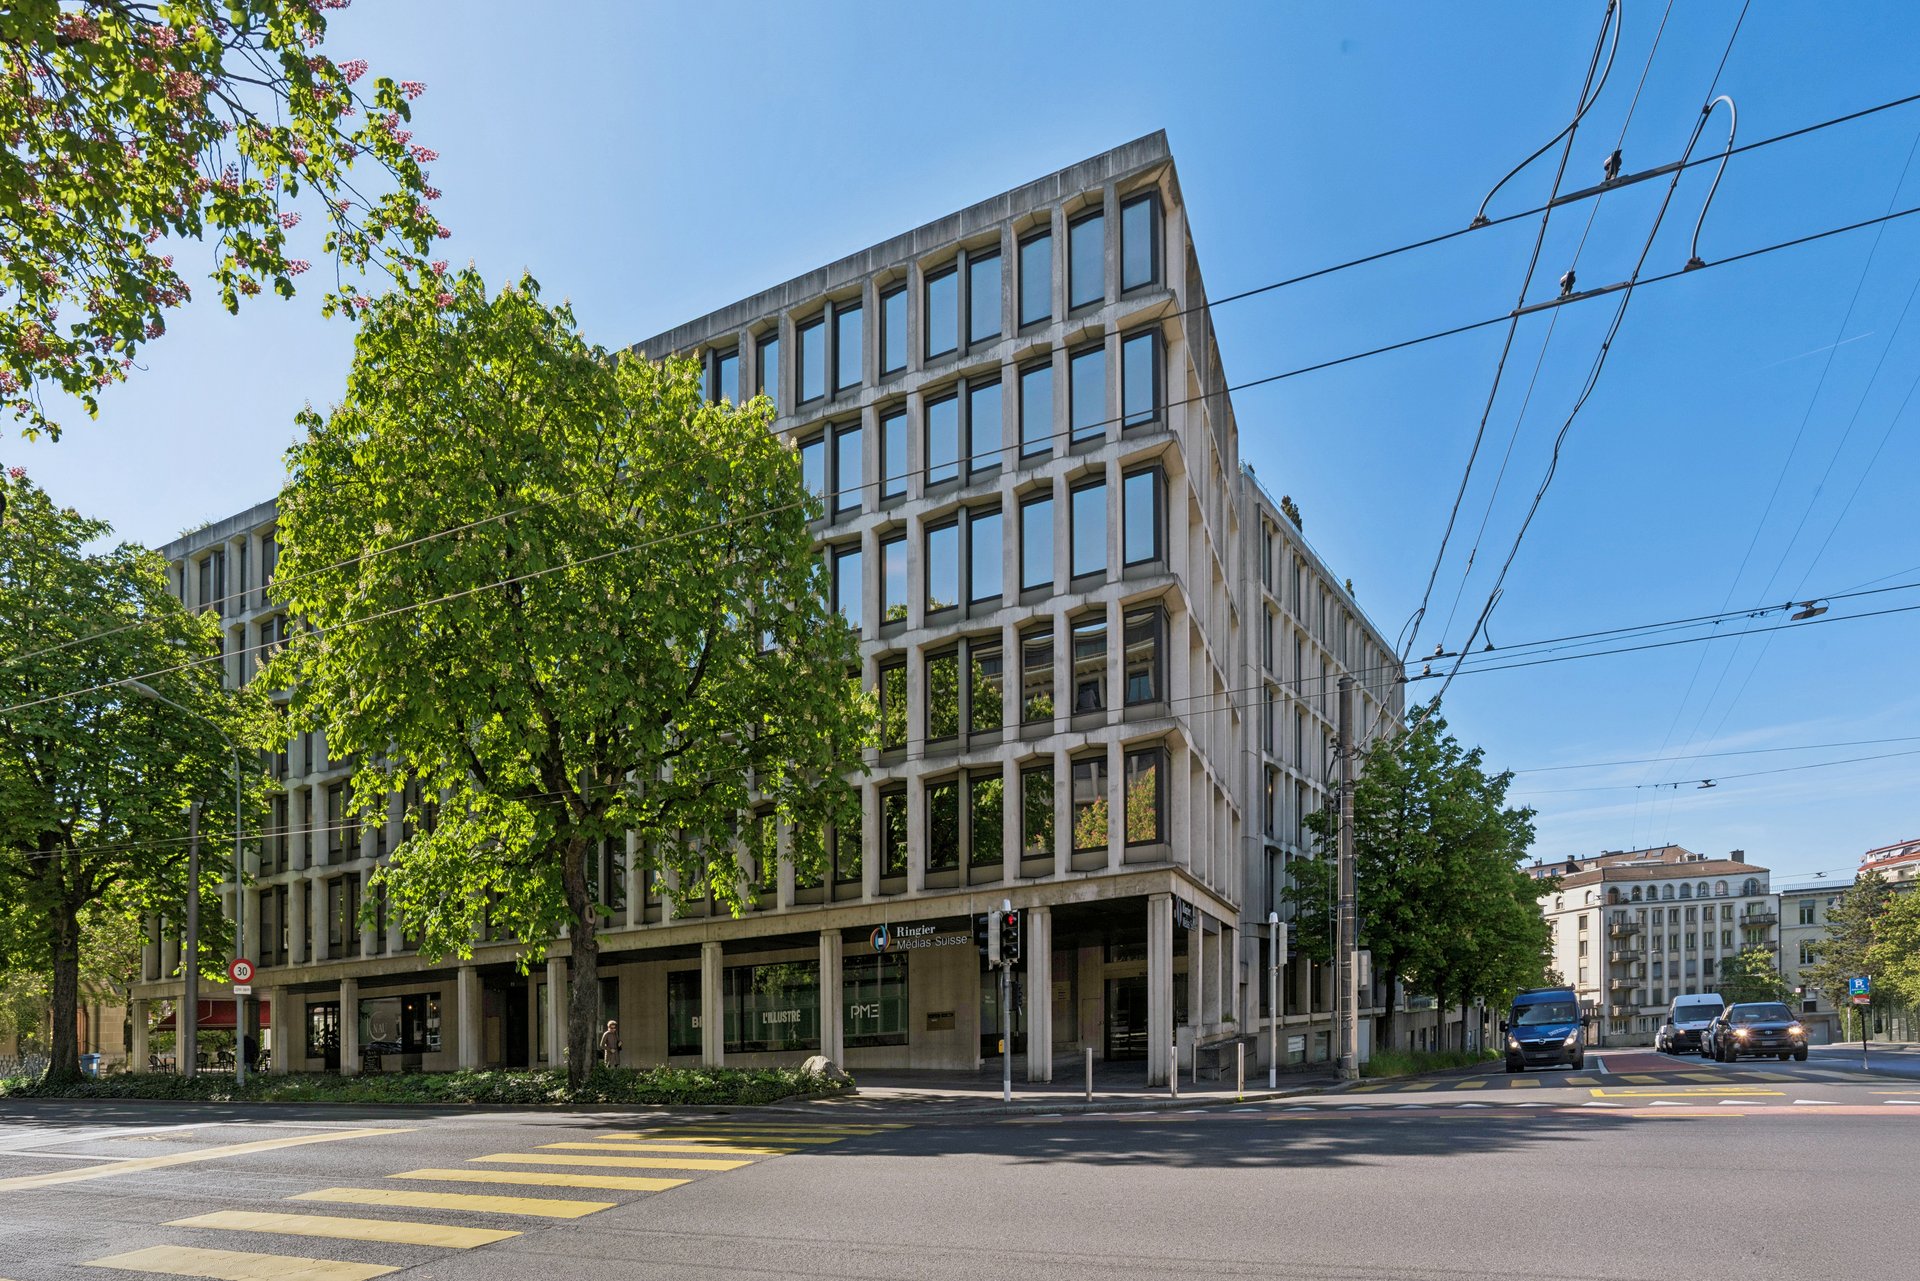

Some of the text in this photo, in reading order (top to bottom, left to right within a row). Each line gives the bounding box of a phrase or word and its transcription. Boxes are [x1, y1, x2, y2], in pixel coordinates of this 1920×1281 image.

[896, 924, 936, 938] Ringier
[897, 935, 968, 950] Médias Suisse
[237, 966, 248, 976] 30
[850, 1003, 880, 1020] PME
